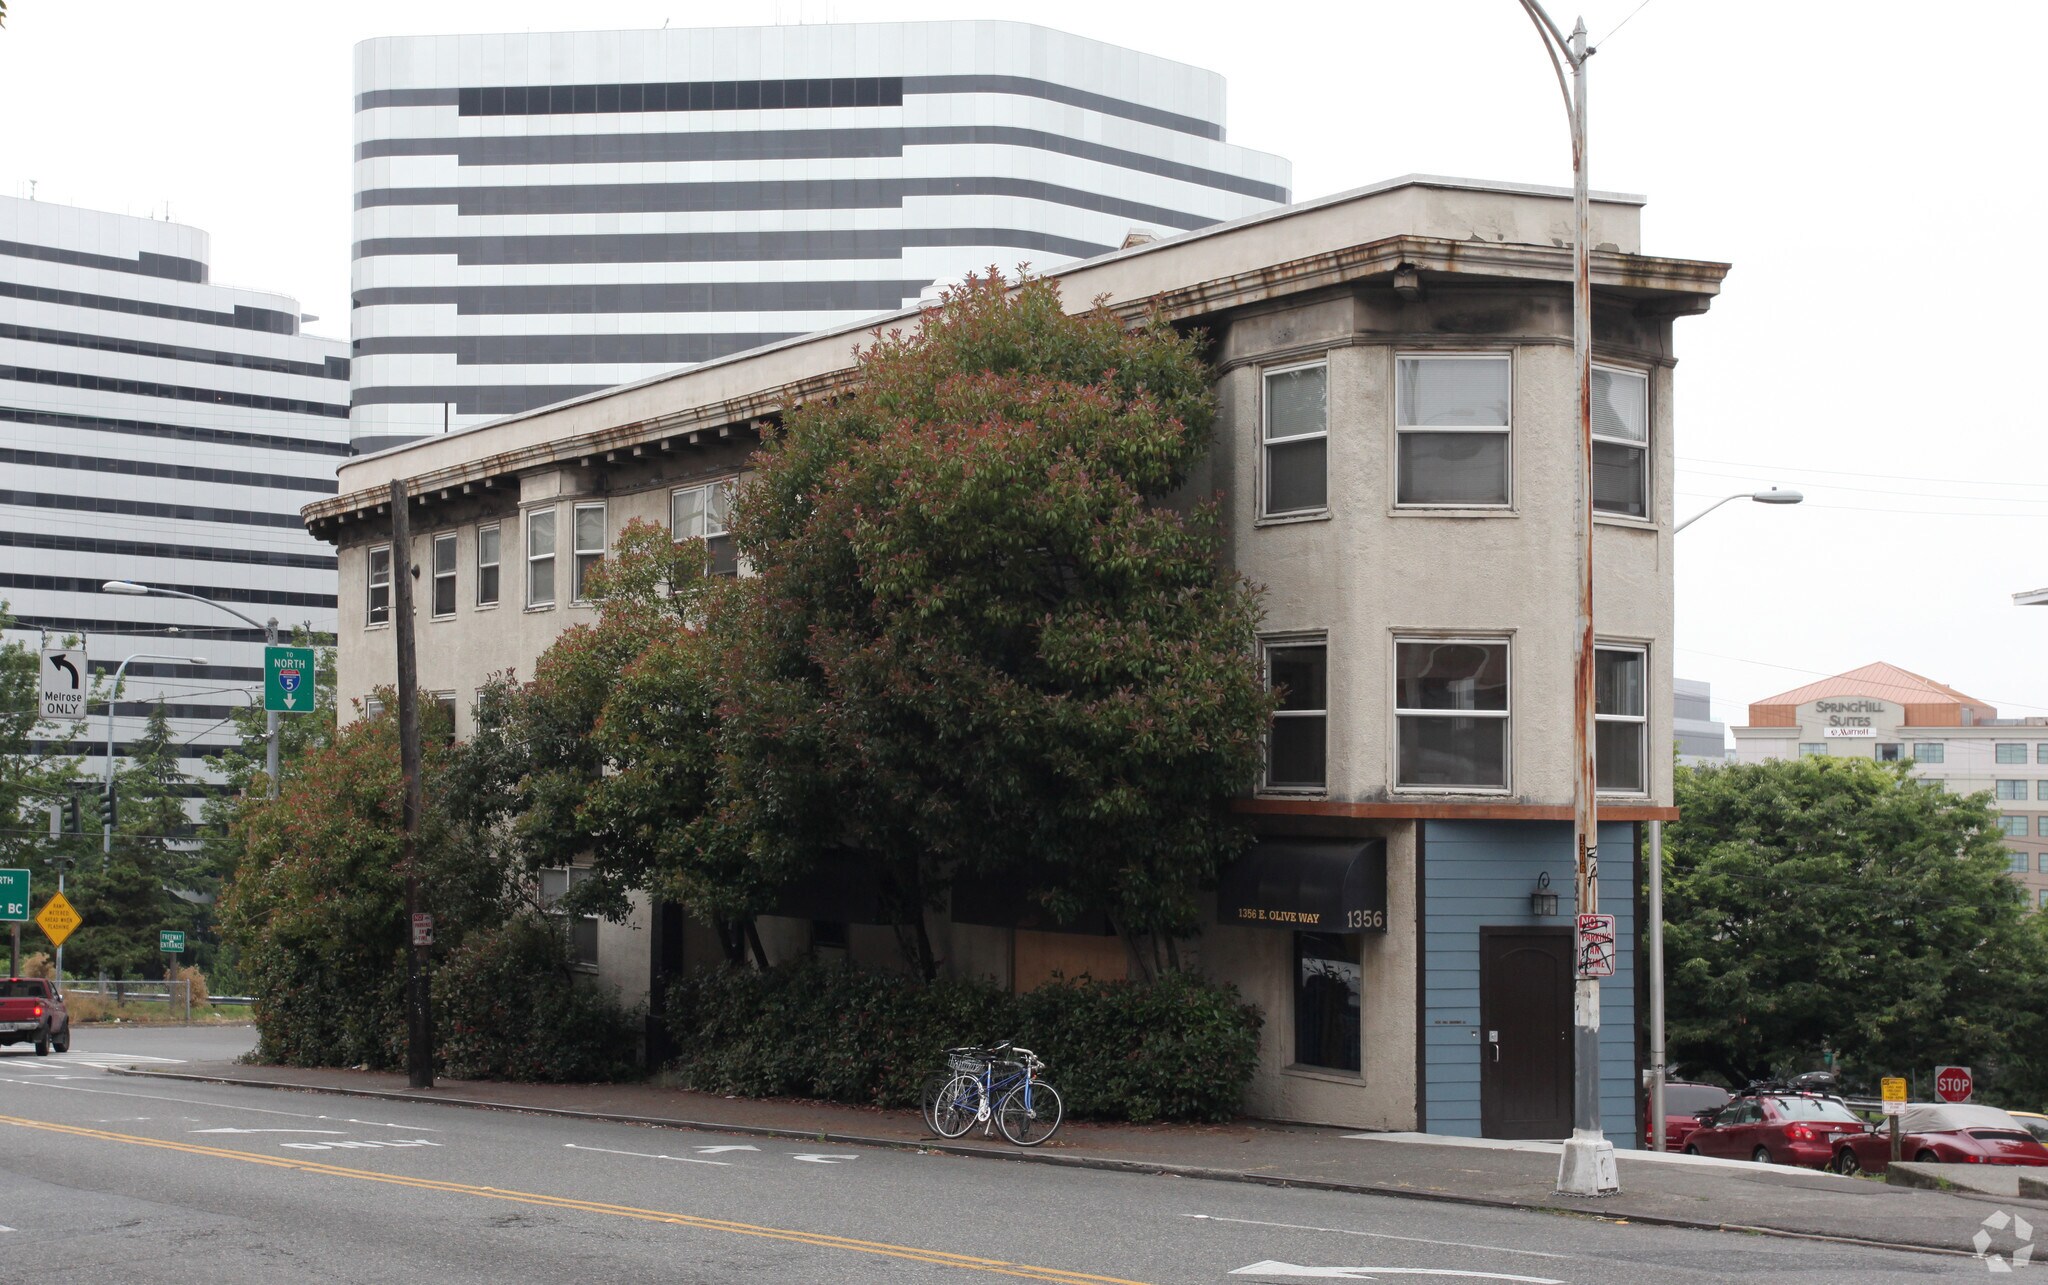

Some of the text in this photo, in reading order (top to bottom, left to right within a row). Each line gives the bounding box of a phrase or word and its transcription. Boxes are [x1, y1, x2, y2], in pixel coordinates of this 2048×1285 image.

[274, 659, 306, 668] NORTH
[286, 679, 294, 690] 5
[45, 692, 82, 702] Melrose
[48, 703, 78, 714] ONLY
[8, 903, 22, 914] BC
[1239, 908, 1320, 924] 1356 E. OLIVE WAY
[1347, 910, 1382, 928] 1356
[1582, 917, 1596, 927] NO
[1582, 932, 1612, 942] PARKING
[1940, 1078, 1969, 1092] STOP
